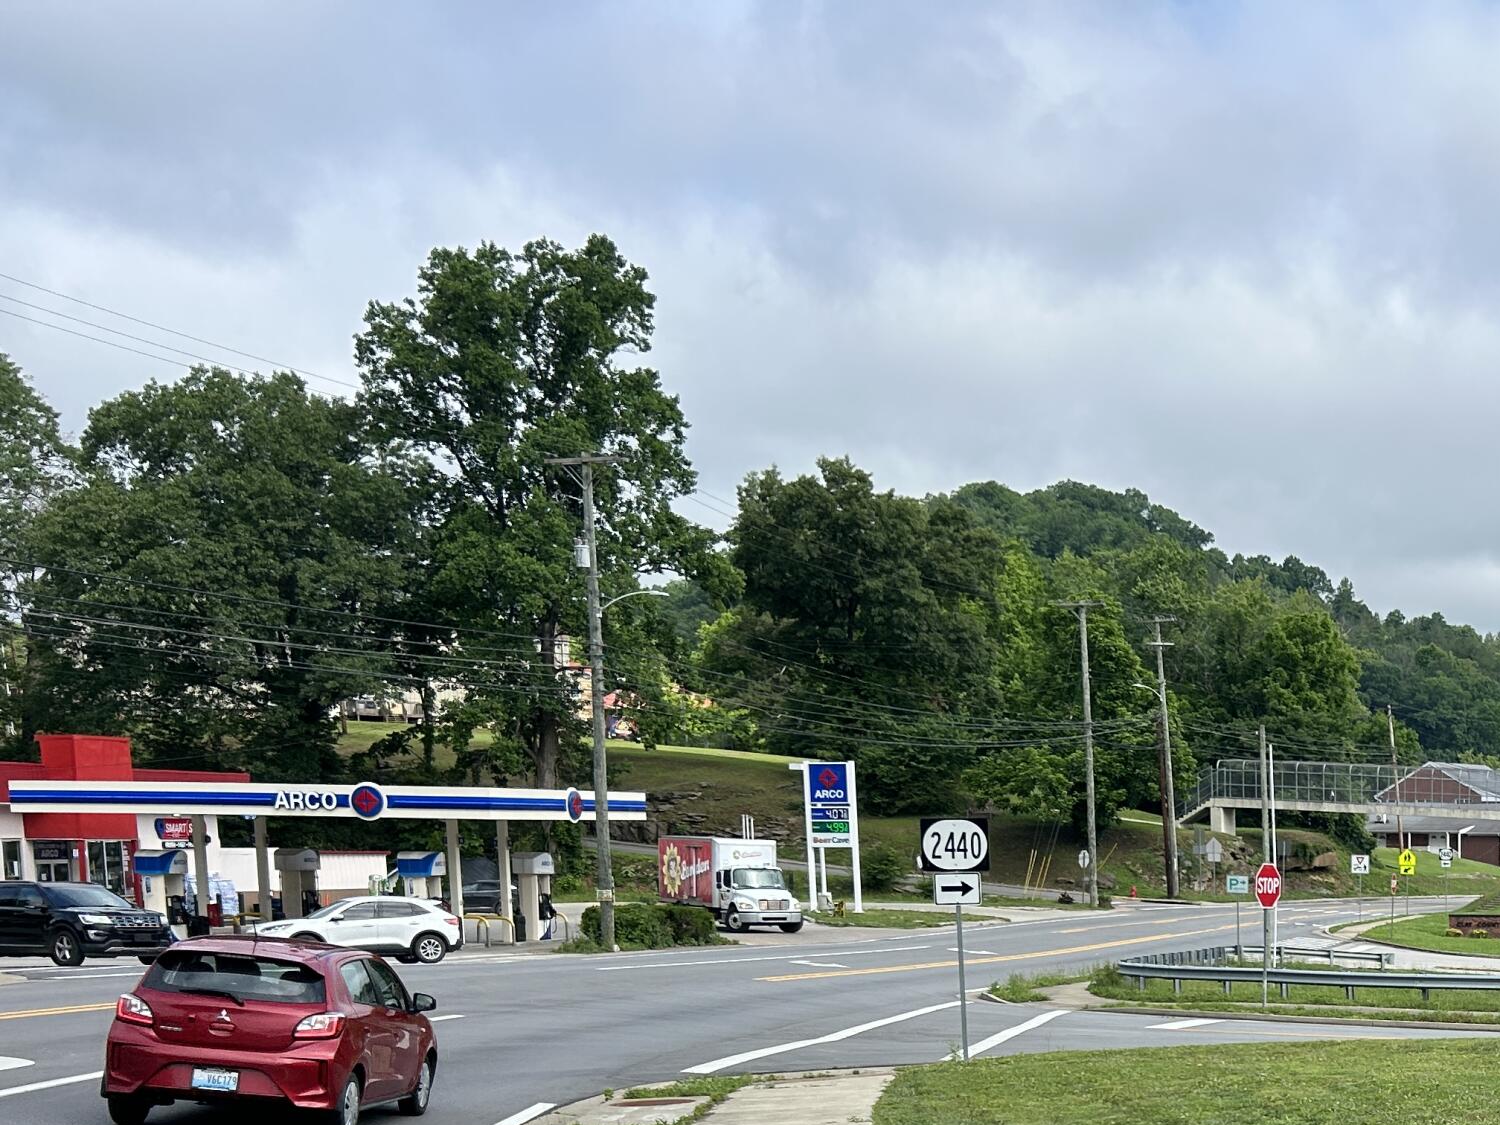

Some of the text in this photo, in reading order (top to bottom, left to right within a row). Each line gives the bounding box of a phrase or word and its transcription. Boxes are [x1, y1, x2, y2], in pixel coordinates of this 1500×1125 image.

[274, 791, 337, 810] ARCO
[814, 790, 844, 799] ARCO
[165, 823, 187, 833] SMART
[931, 832, 981, 859] 2440
[1257, 877, 1279, 894] STOP
